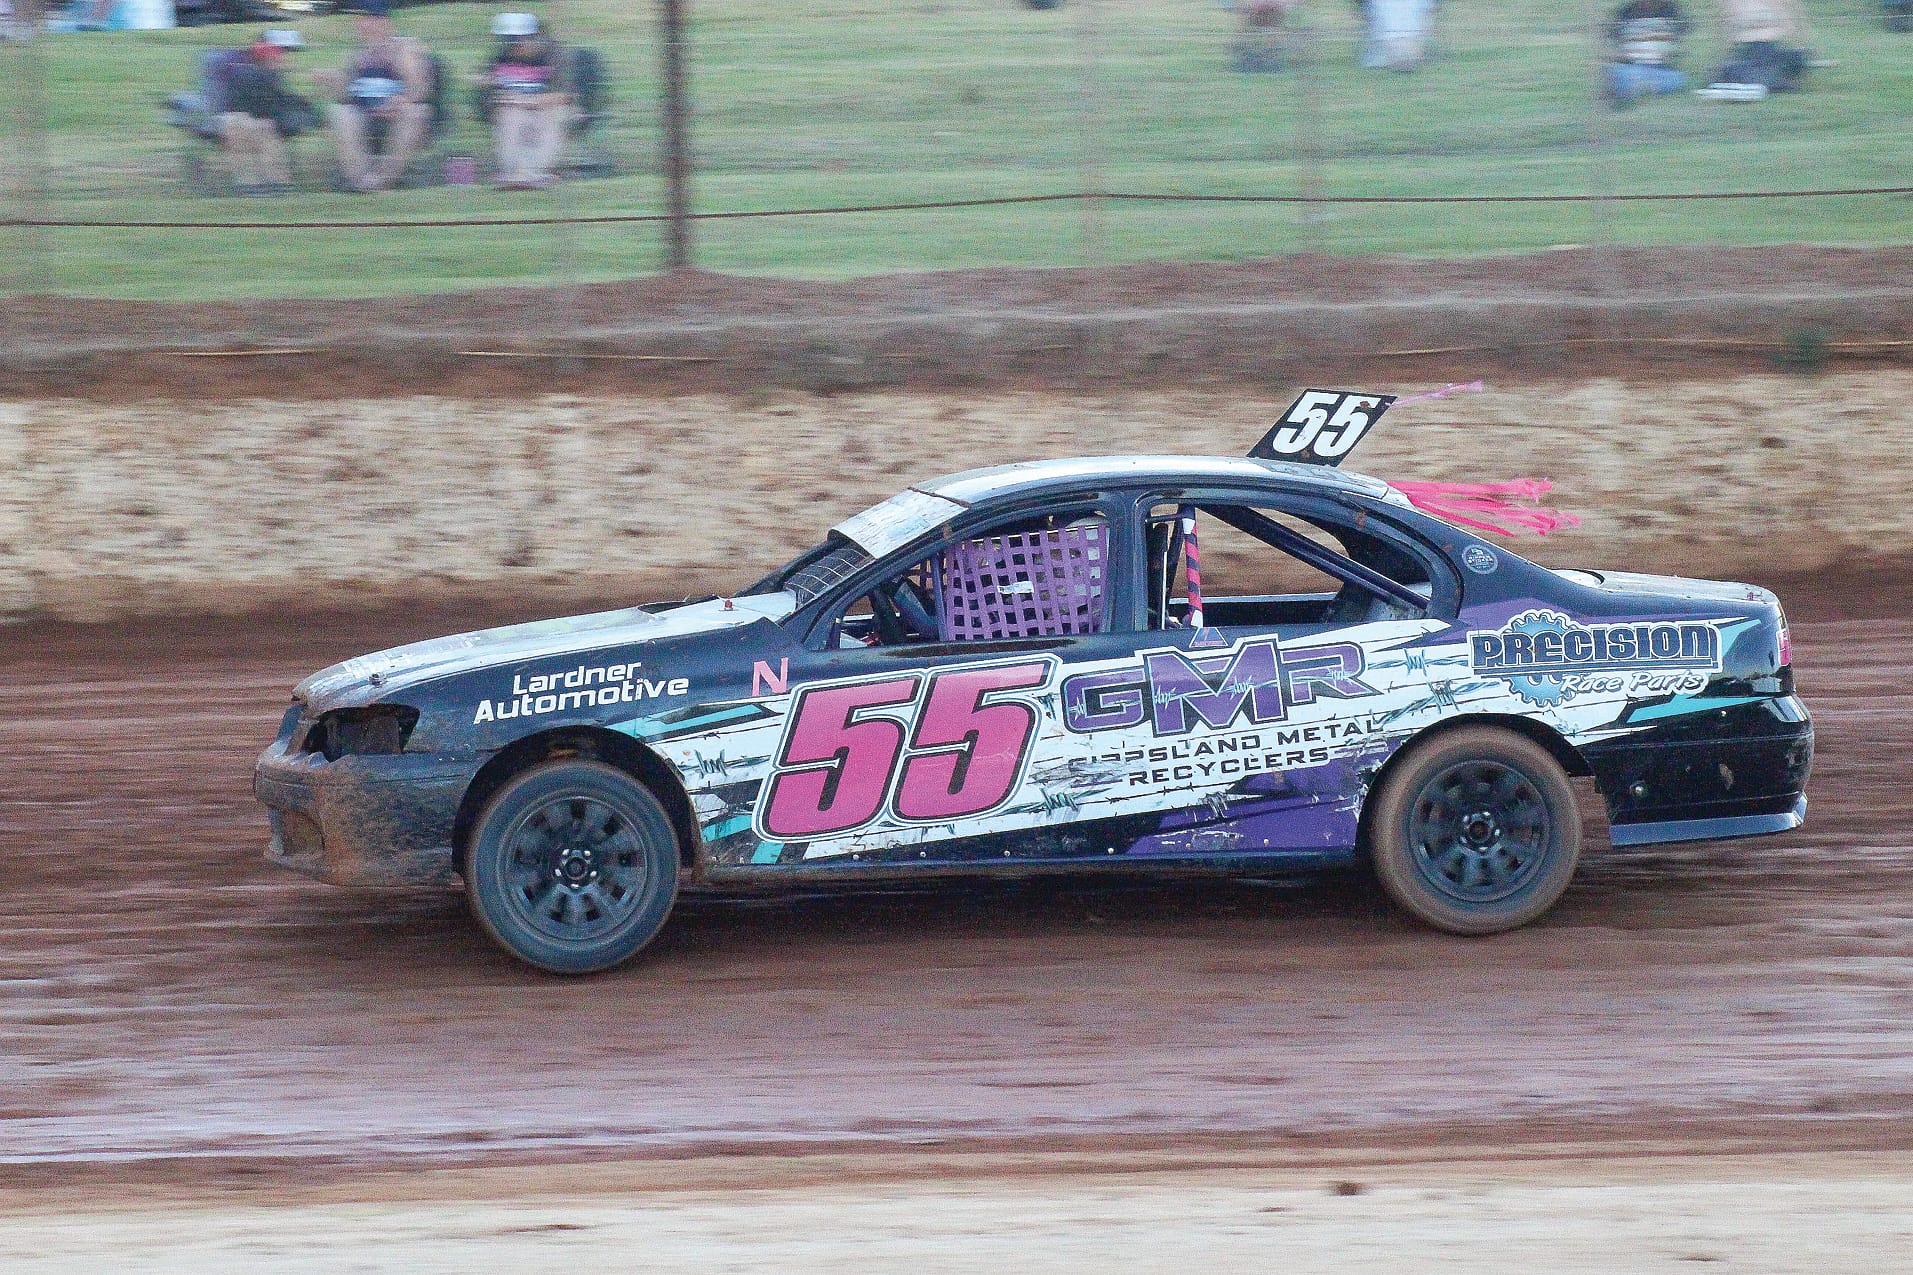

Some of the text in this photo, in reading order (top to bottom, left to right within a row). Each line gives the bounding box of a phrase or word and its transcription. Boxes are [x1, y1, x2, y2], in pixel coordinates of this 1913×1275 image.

[1272, 391, 1382, 457] 55
[1471, 624, 1717, 668] PRECISION
[512, 661, 642, 695] Lardner
[752, 657, 789, 696] N
[1061, 639, 1384, 738] GMR
[1560, 670, 1702, 693] Race Parts
[473, 677, 690, 724] Automotive
[762, 658, 1058, 838] 55
[1277, 719, 1384, 746] METAL
[1129, 747, 1330, 786] RECYCLERS
